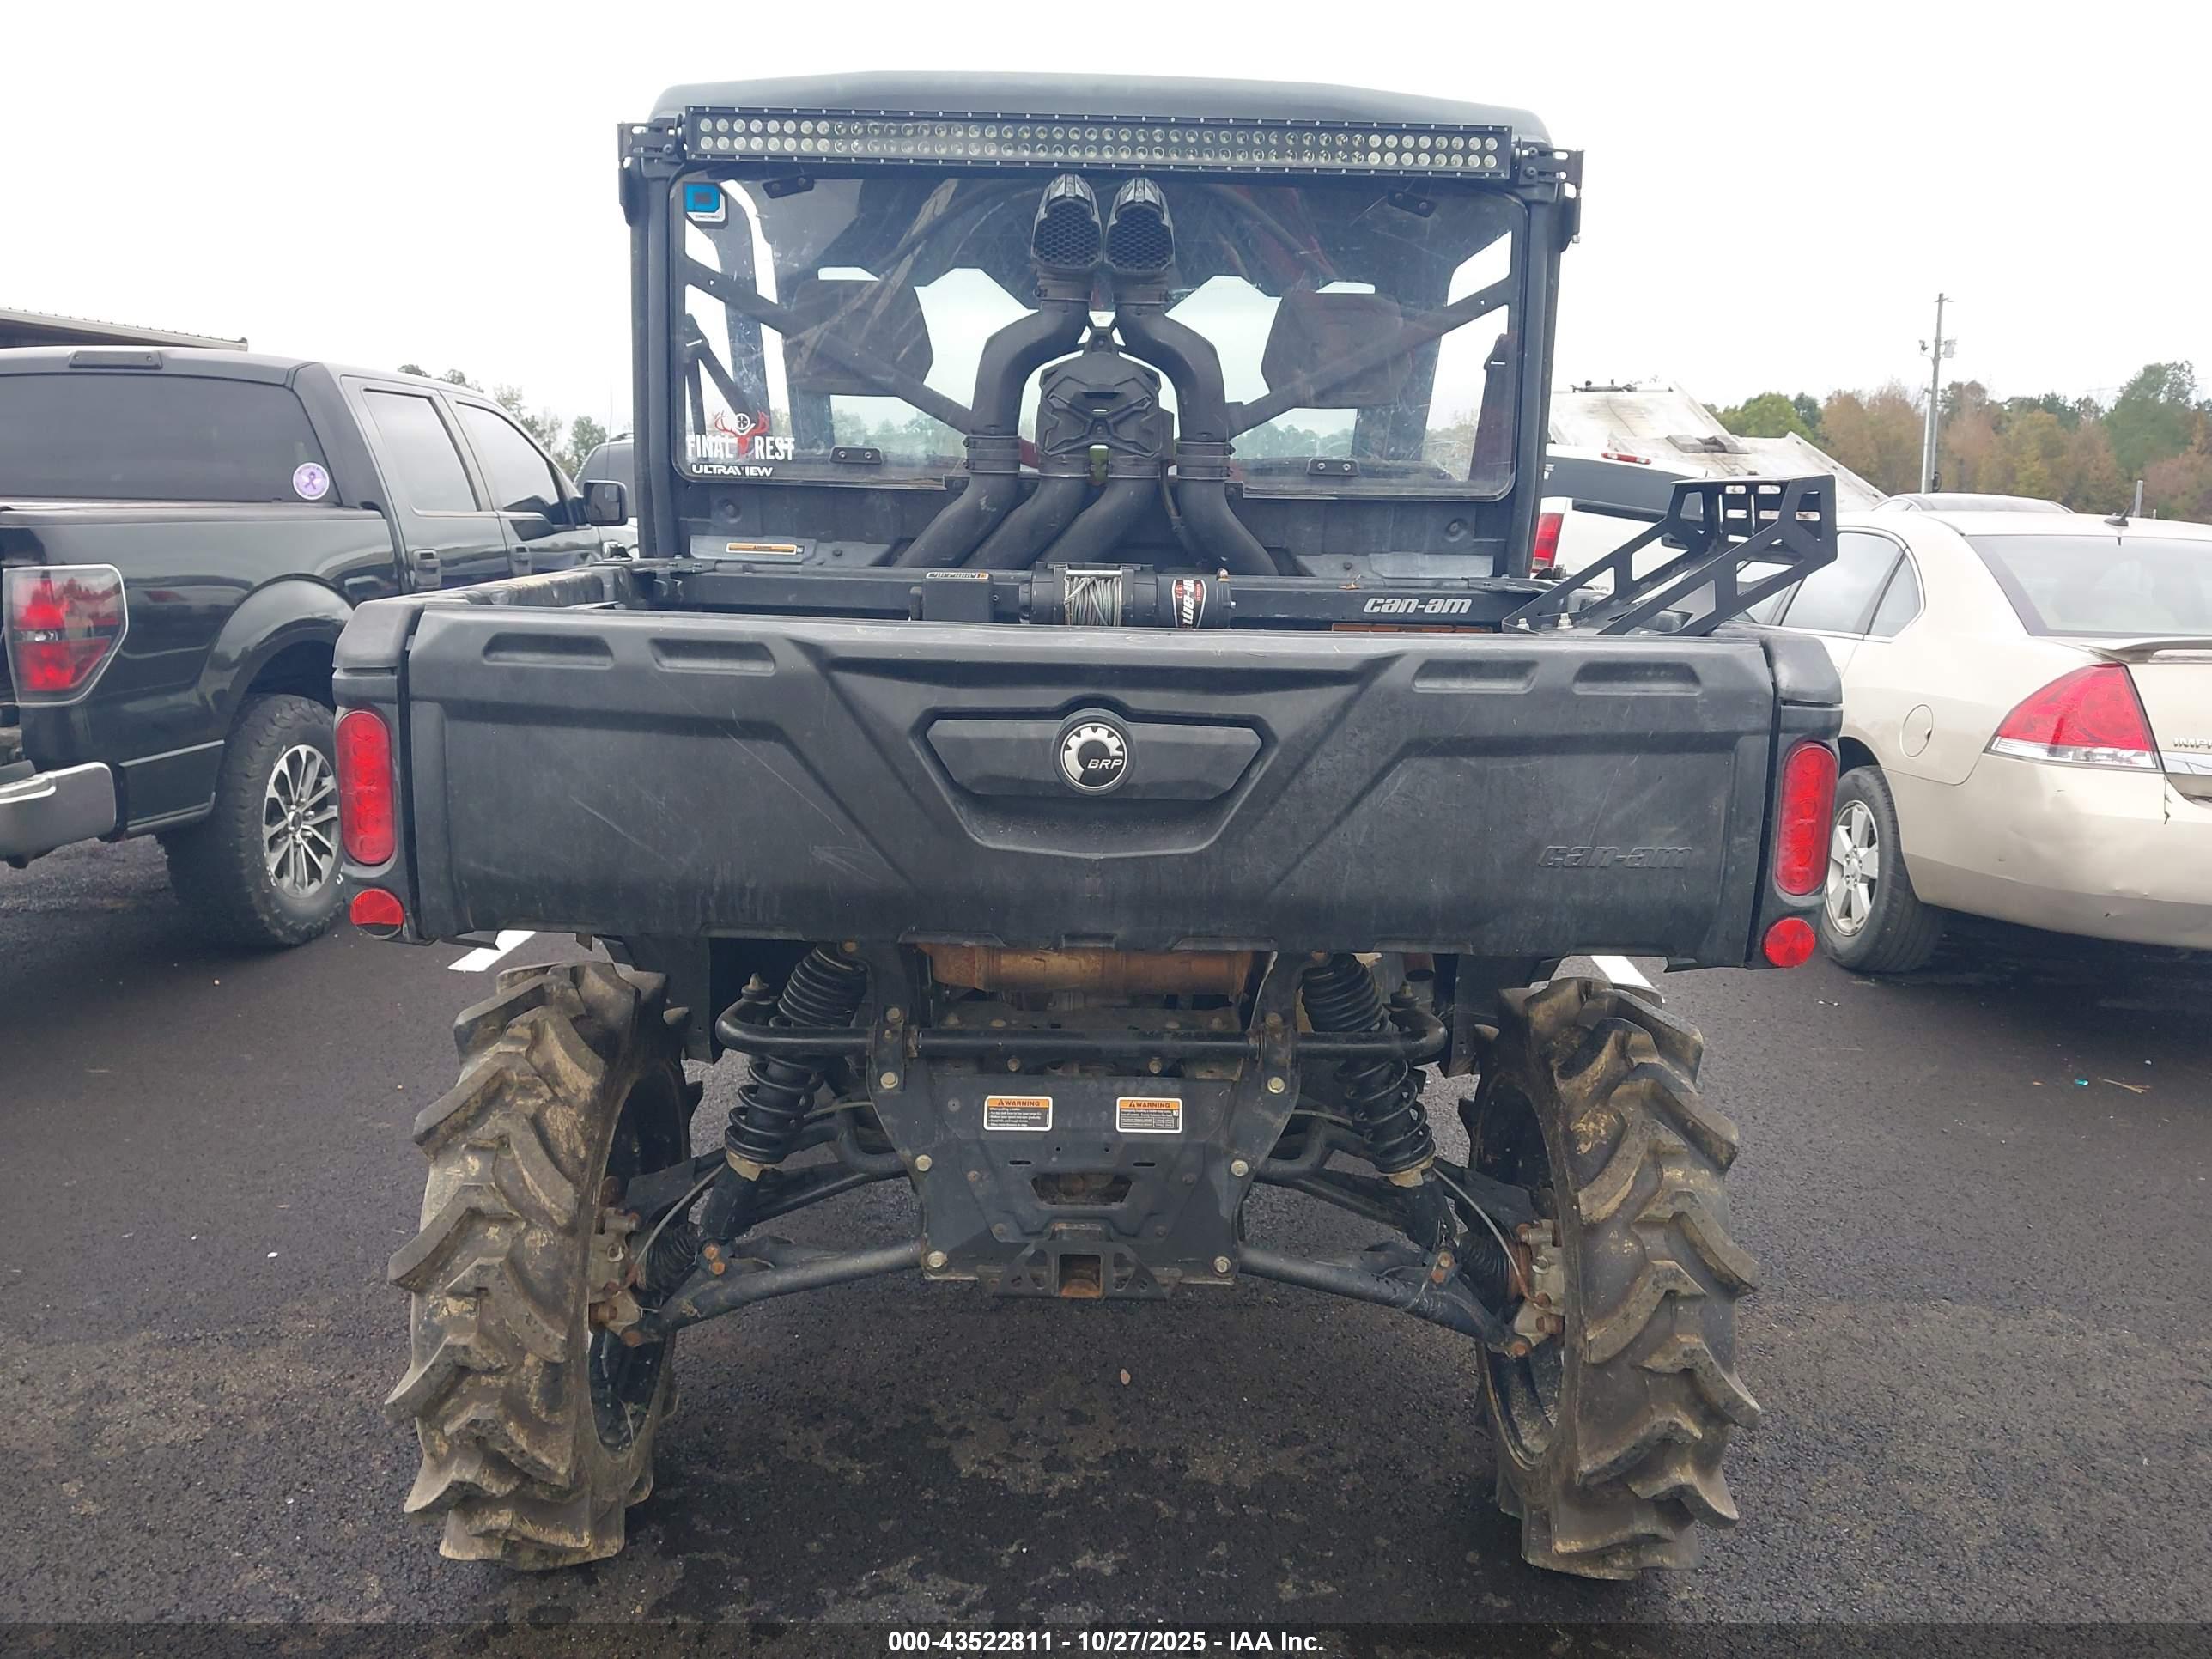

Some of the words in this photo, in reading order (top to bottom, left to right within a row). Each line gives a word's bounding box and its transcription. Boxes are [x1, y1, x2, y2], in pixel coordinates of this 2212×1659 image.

[686, 434, 734, 459] FINAL
[754, 435, 795, 460] REST
[1363, 598, 1472, 614] can-am
[2173, 737, 2212, 749] IMP
[1087, 758, 1123, 769] BRP
[1539, 845, 1692, 869] can-am
